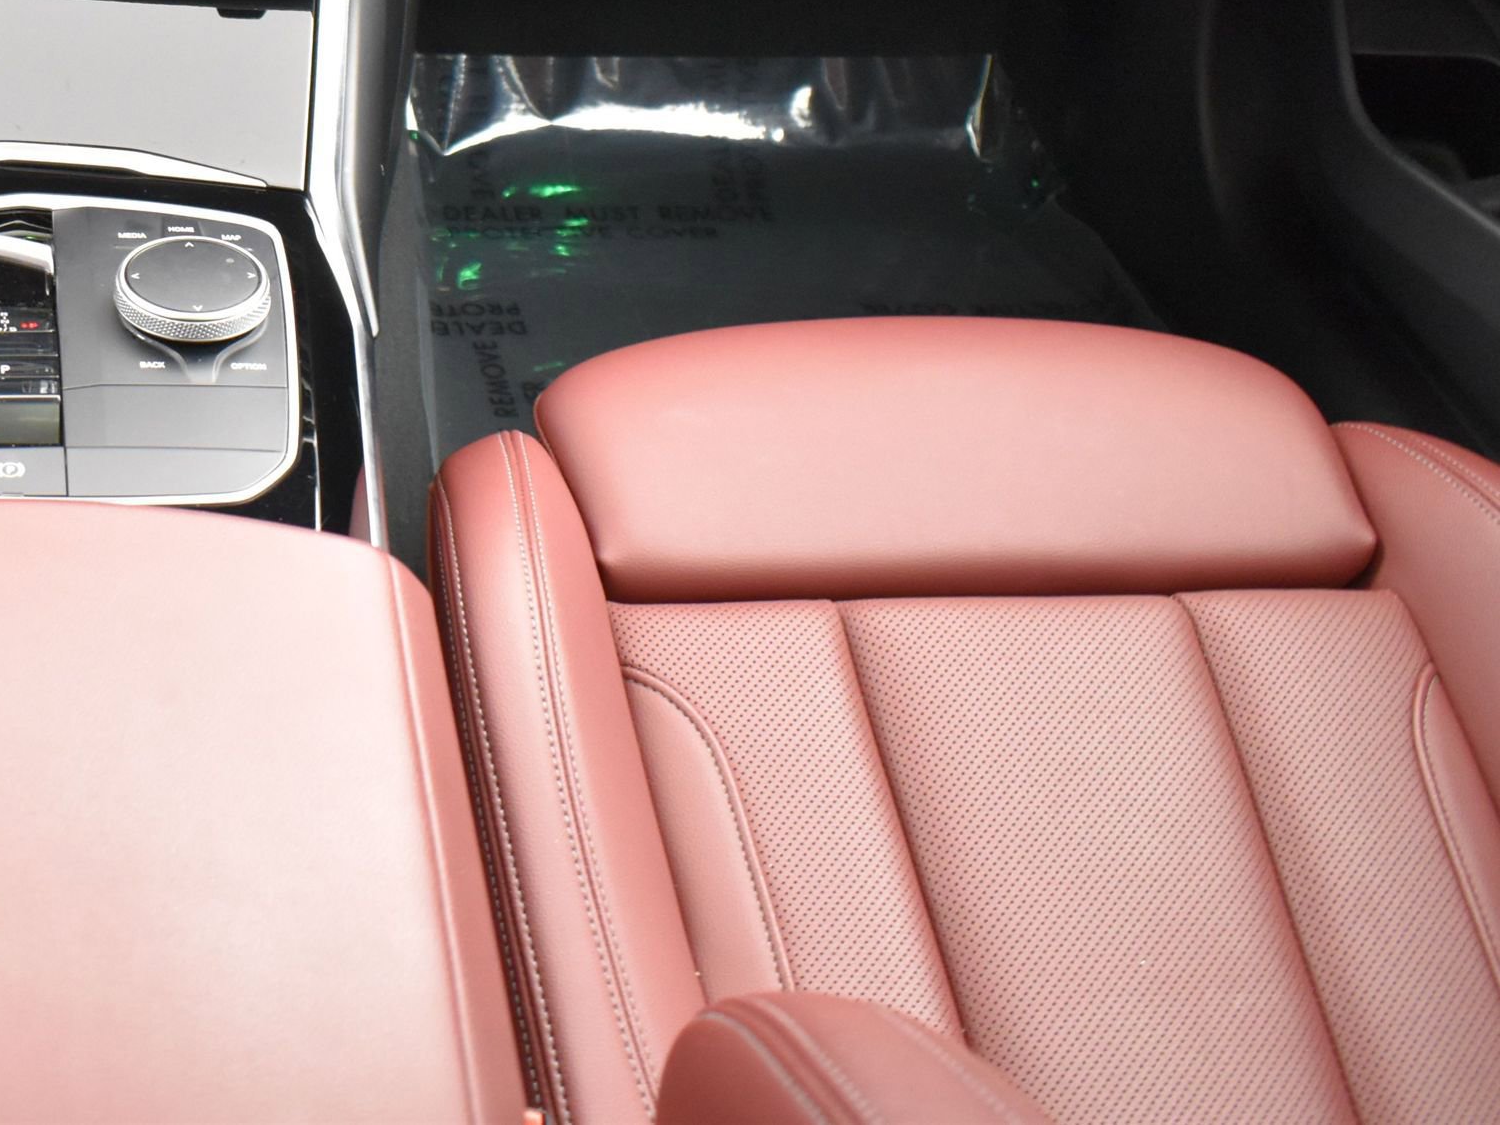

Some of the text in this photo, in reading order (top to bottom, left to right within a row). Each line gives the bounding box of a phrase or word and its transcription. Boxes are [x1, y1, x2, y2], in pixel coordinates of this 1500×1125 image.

[117, 231, 148, 239] MEDIA
[220, 233, 242, 241] MAP
[139, 361, 166, 369] BACK
[230, 362, 268, 371] OPTION
[0, 365, 11, 375] P
